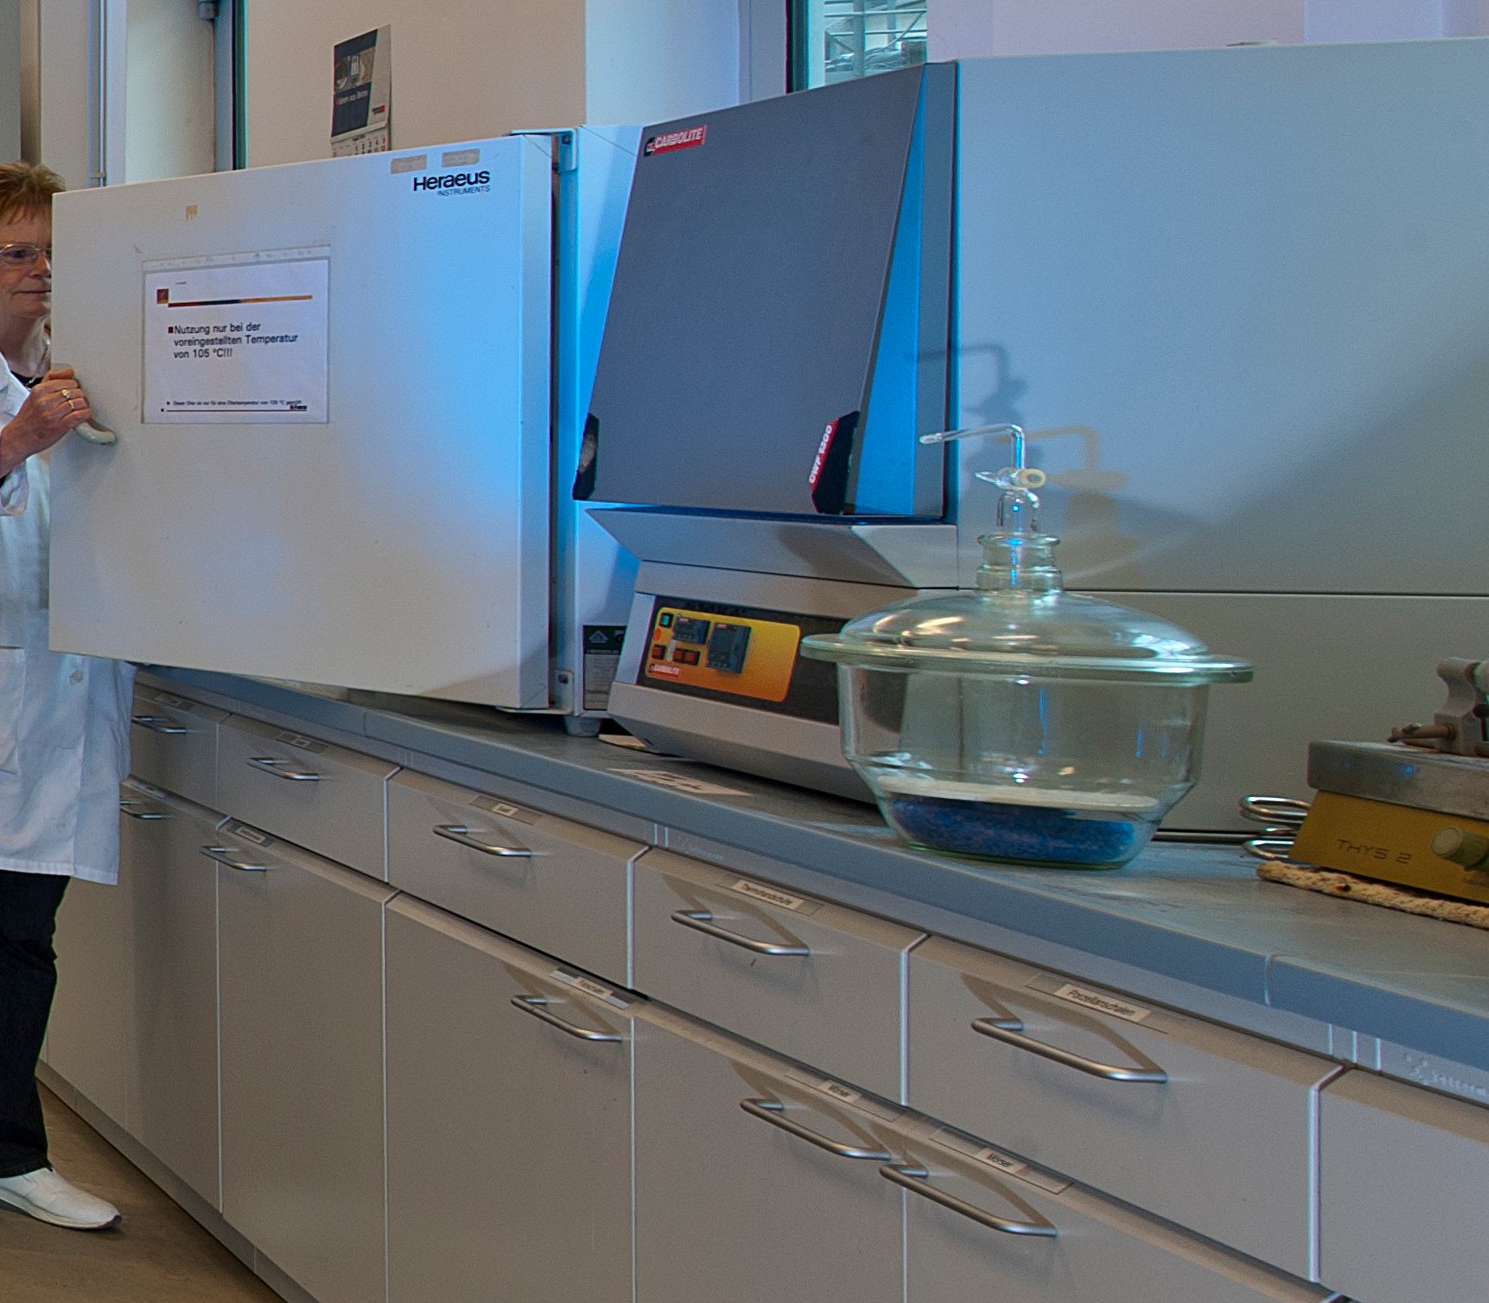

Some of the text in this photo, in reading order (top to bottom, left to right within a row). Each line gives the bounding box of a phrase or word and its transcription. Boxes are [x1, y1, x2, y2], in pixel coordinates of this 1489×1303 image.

[413, 170, 490, 191] Heraeus
[437, 185, 490, 197] INSTRUMENTS
[174, 322, 261, 335] Nutzung nur bei der
[174, 334, 298, 347] voreingestellten Temperatur
[193, 349, 209, 357] 105
[1338, 839, 1412, 865] THYS 2
